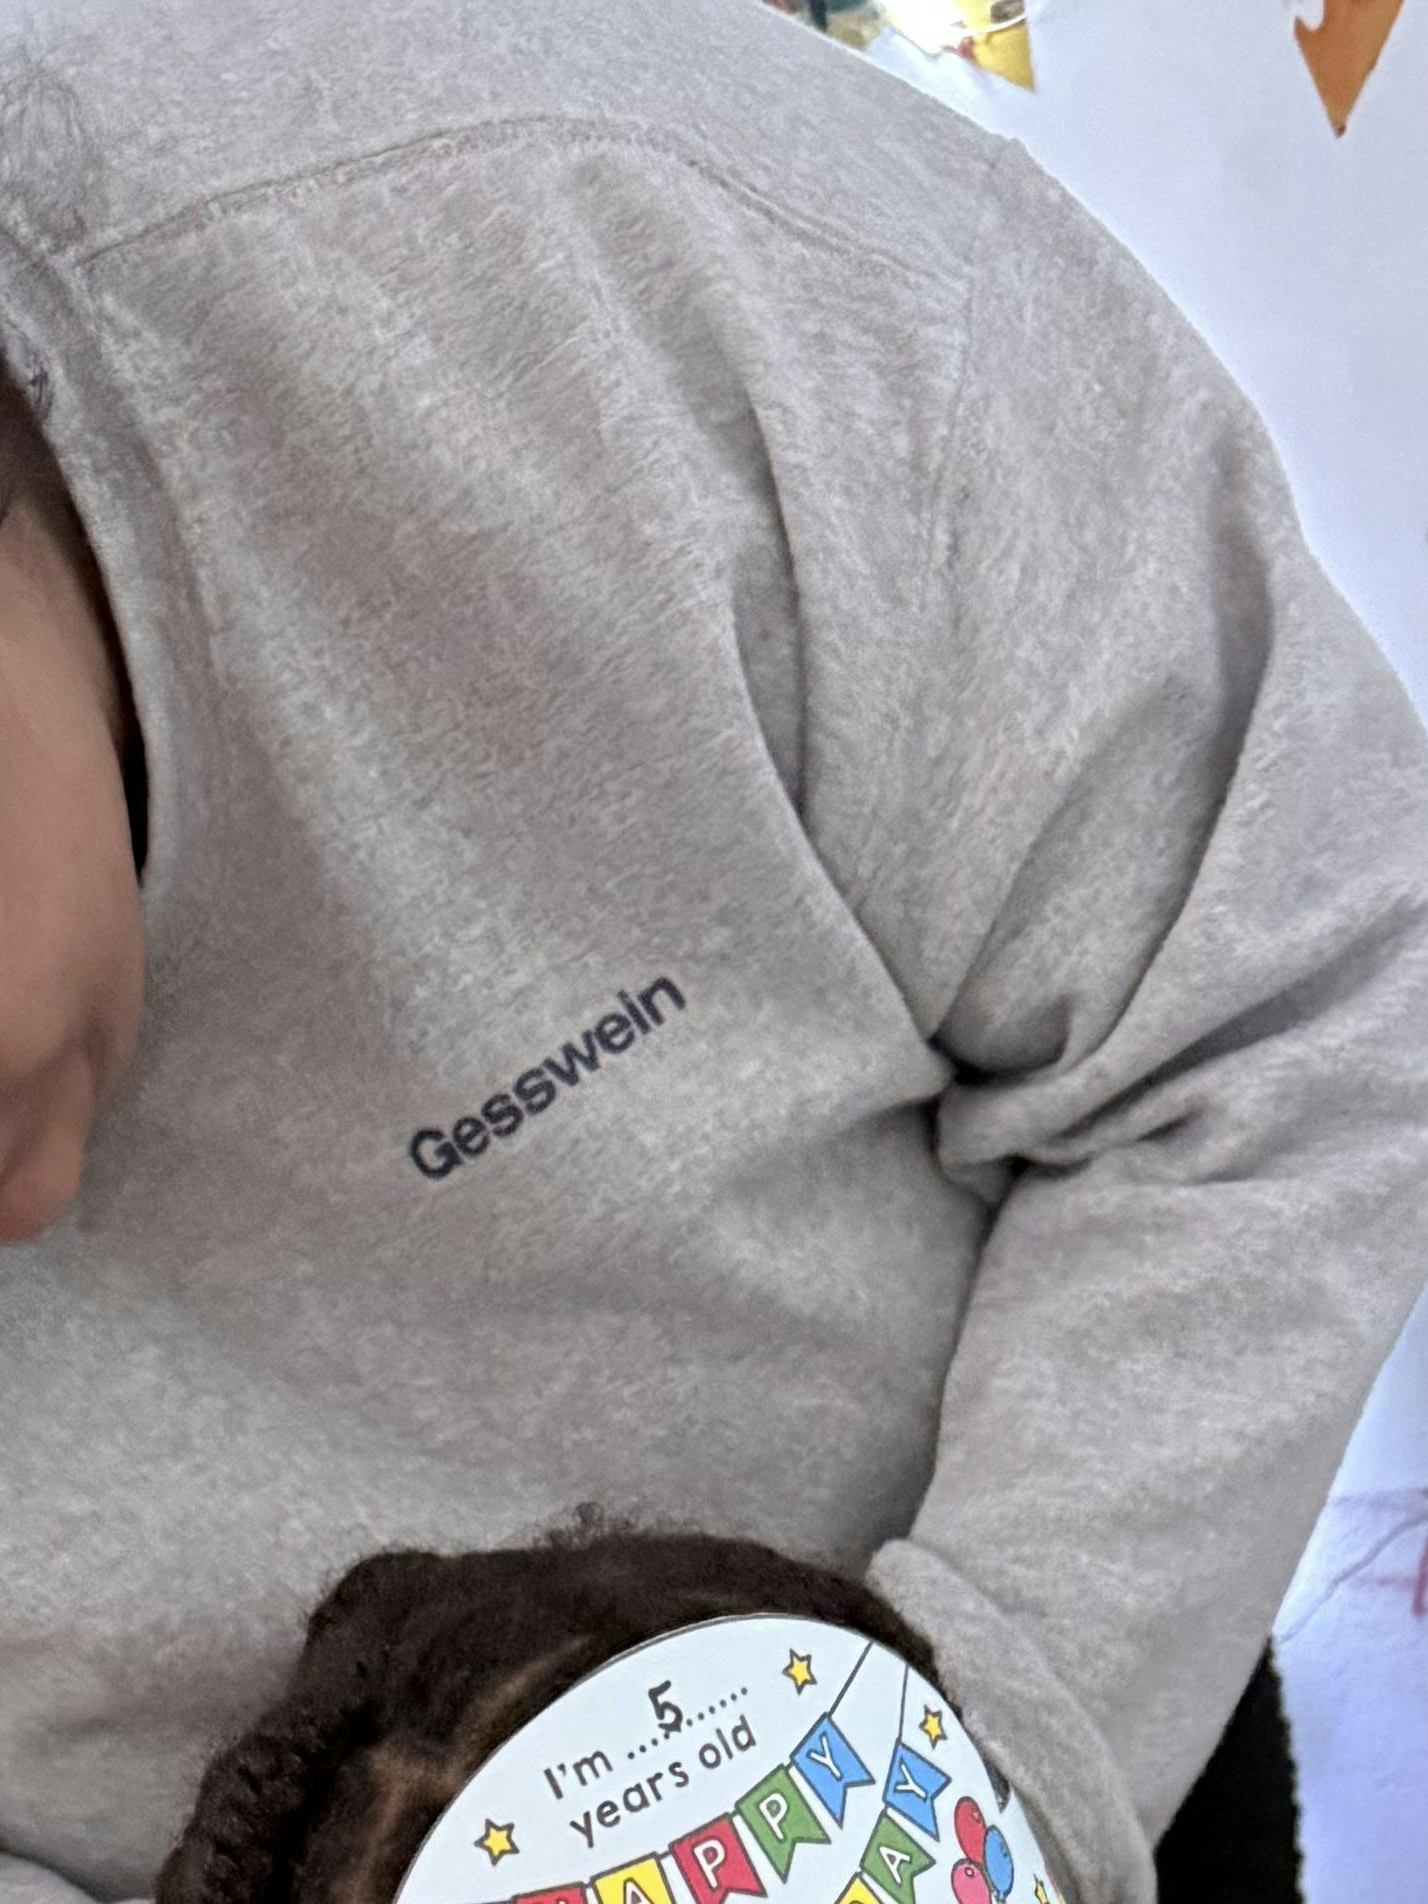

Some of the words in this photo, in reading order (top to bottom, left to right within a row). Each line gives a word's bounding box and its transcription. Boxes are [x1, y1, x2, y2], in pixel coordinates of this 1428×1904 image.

[542, 1750, 613, 1801] I'm
[648, 1679, 684, 1734] 5
[569, 1761, 690, 1849] years
[698, 1713, 757, 1770] old
